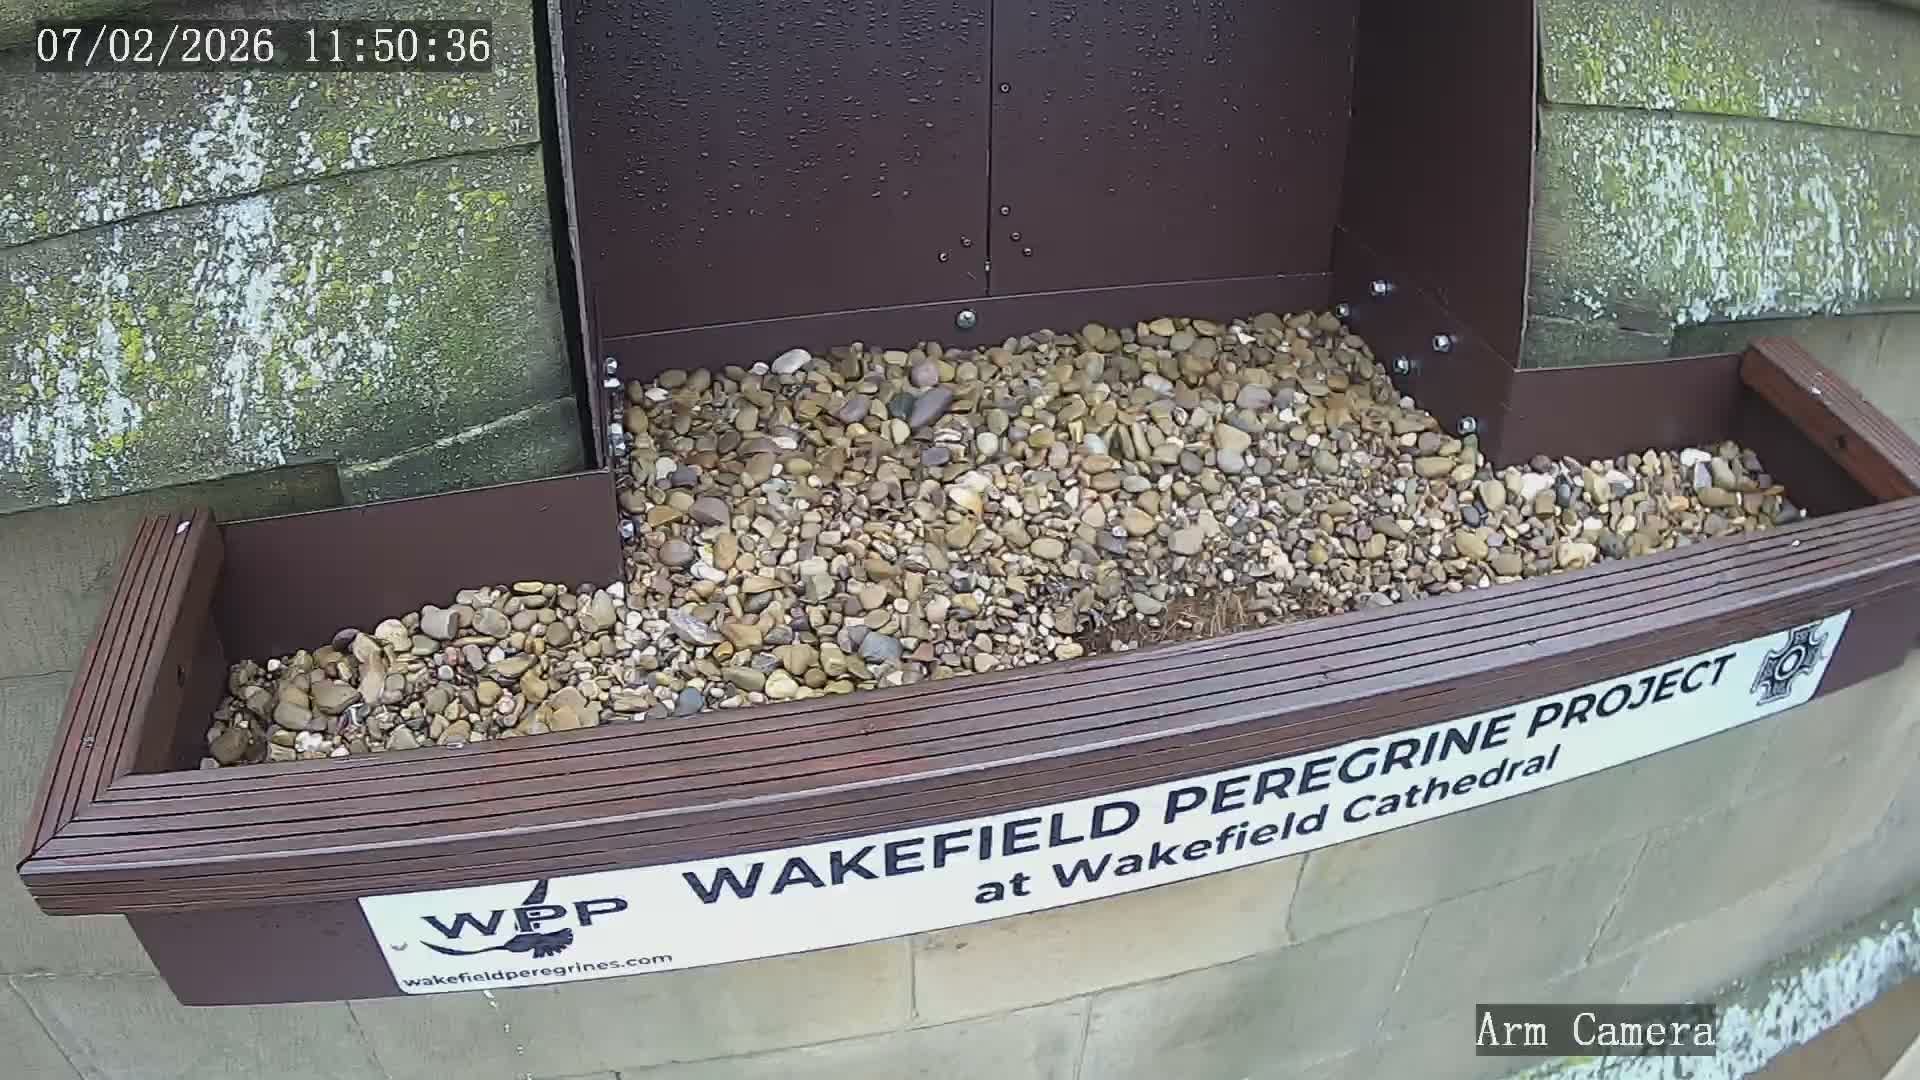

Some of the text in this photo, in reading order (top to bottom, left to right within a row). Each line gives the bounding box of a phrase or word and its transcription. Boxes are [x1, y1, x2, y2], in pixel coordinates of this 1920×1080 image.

[682, 653, 1737, 905] WAKEFIELD PEREGRINE PROJECT
[974, 745, 1562, 904] at Wakefield Cathedral
[420, 898, 629, 939] WPP
[402, 952, 673, 988] wakefieldperegrines.com
